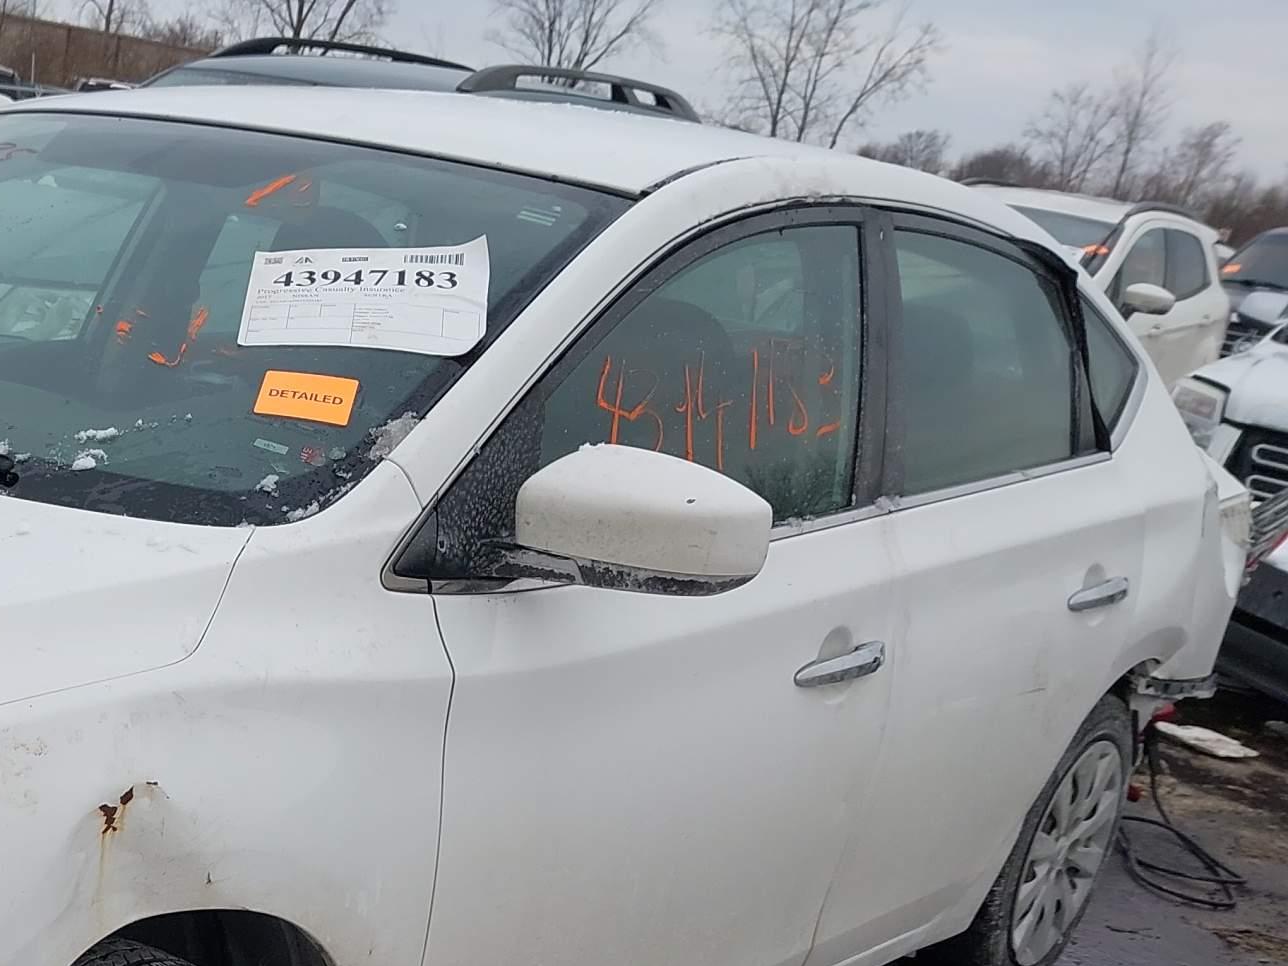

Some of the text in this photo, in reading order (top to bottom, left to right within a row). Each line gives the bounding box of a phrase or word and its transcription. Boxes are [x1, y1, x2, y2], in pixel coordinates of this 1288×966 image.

[273, 269, 458, 289] 43947183
[257, 287, 312, 295] Progressive
[268, 388, 344, 405] DETAILED
